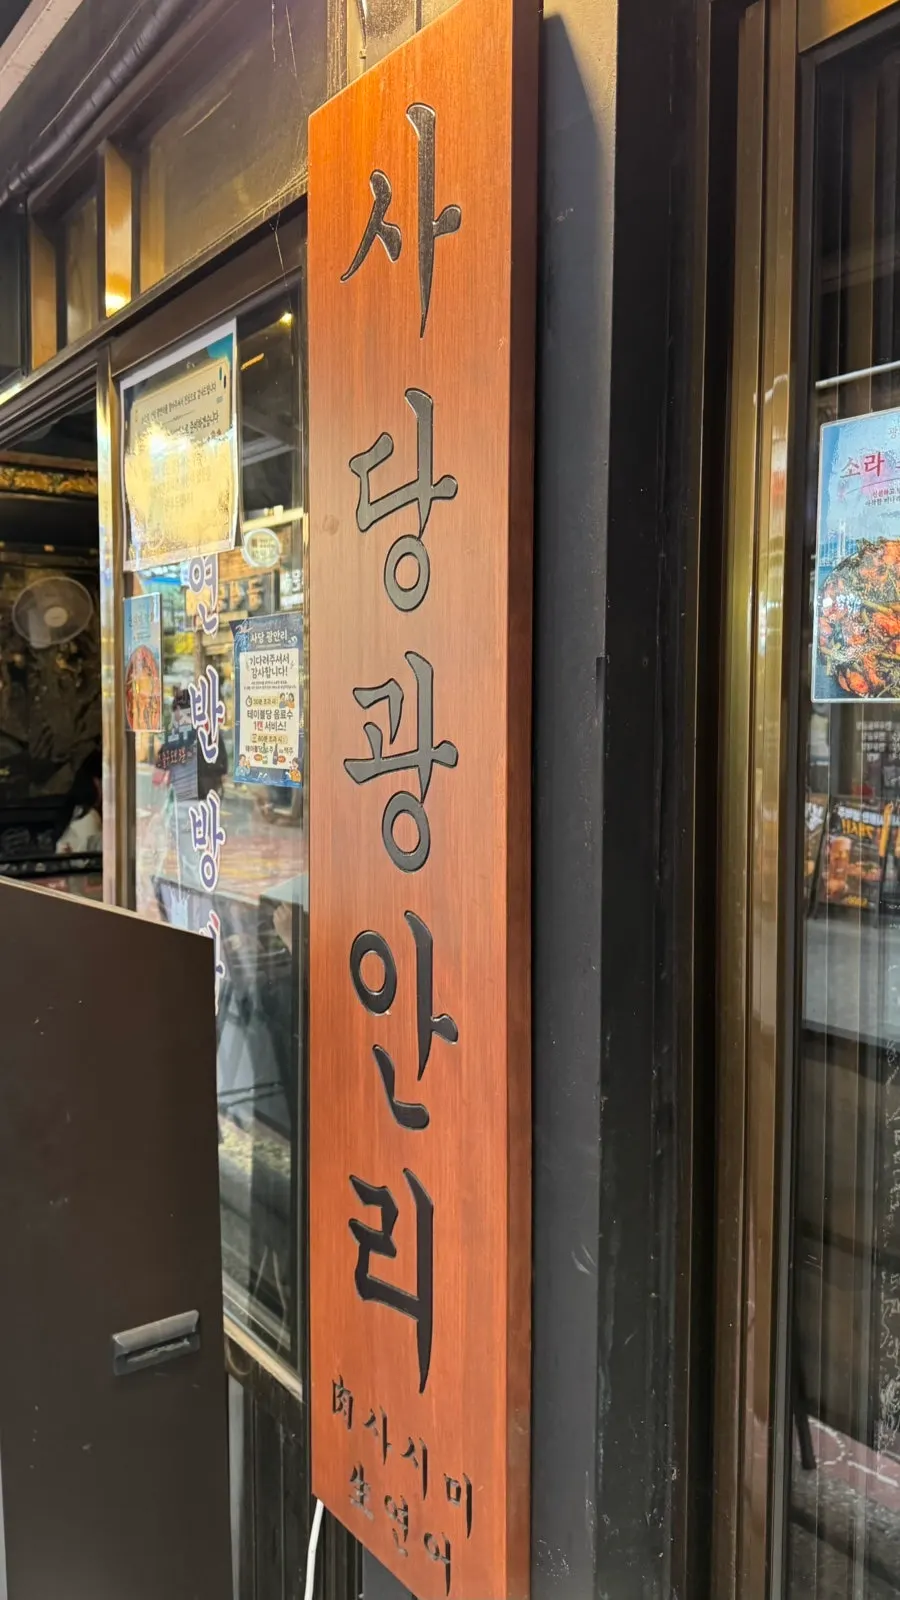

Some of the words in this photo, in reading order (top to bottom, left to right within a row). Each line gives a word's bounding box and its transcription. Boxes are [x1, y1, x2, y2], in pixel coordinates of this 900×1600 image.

[840, 451, 885, 479] 소라
[266, 628, 288, 643] 광안리
[251, 666, 288, 679] 감사합니다!
[247, 709, 272, 720] 테이블당
[273, 709, 294, 720] 음료수
[264, 721, 287, 732] 서비스!
